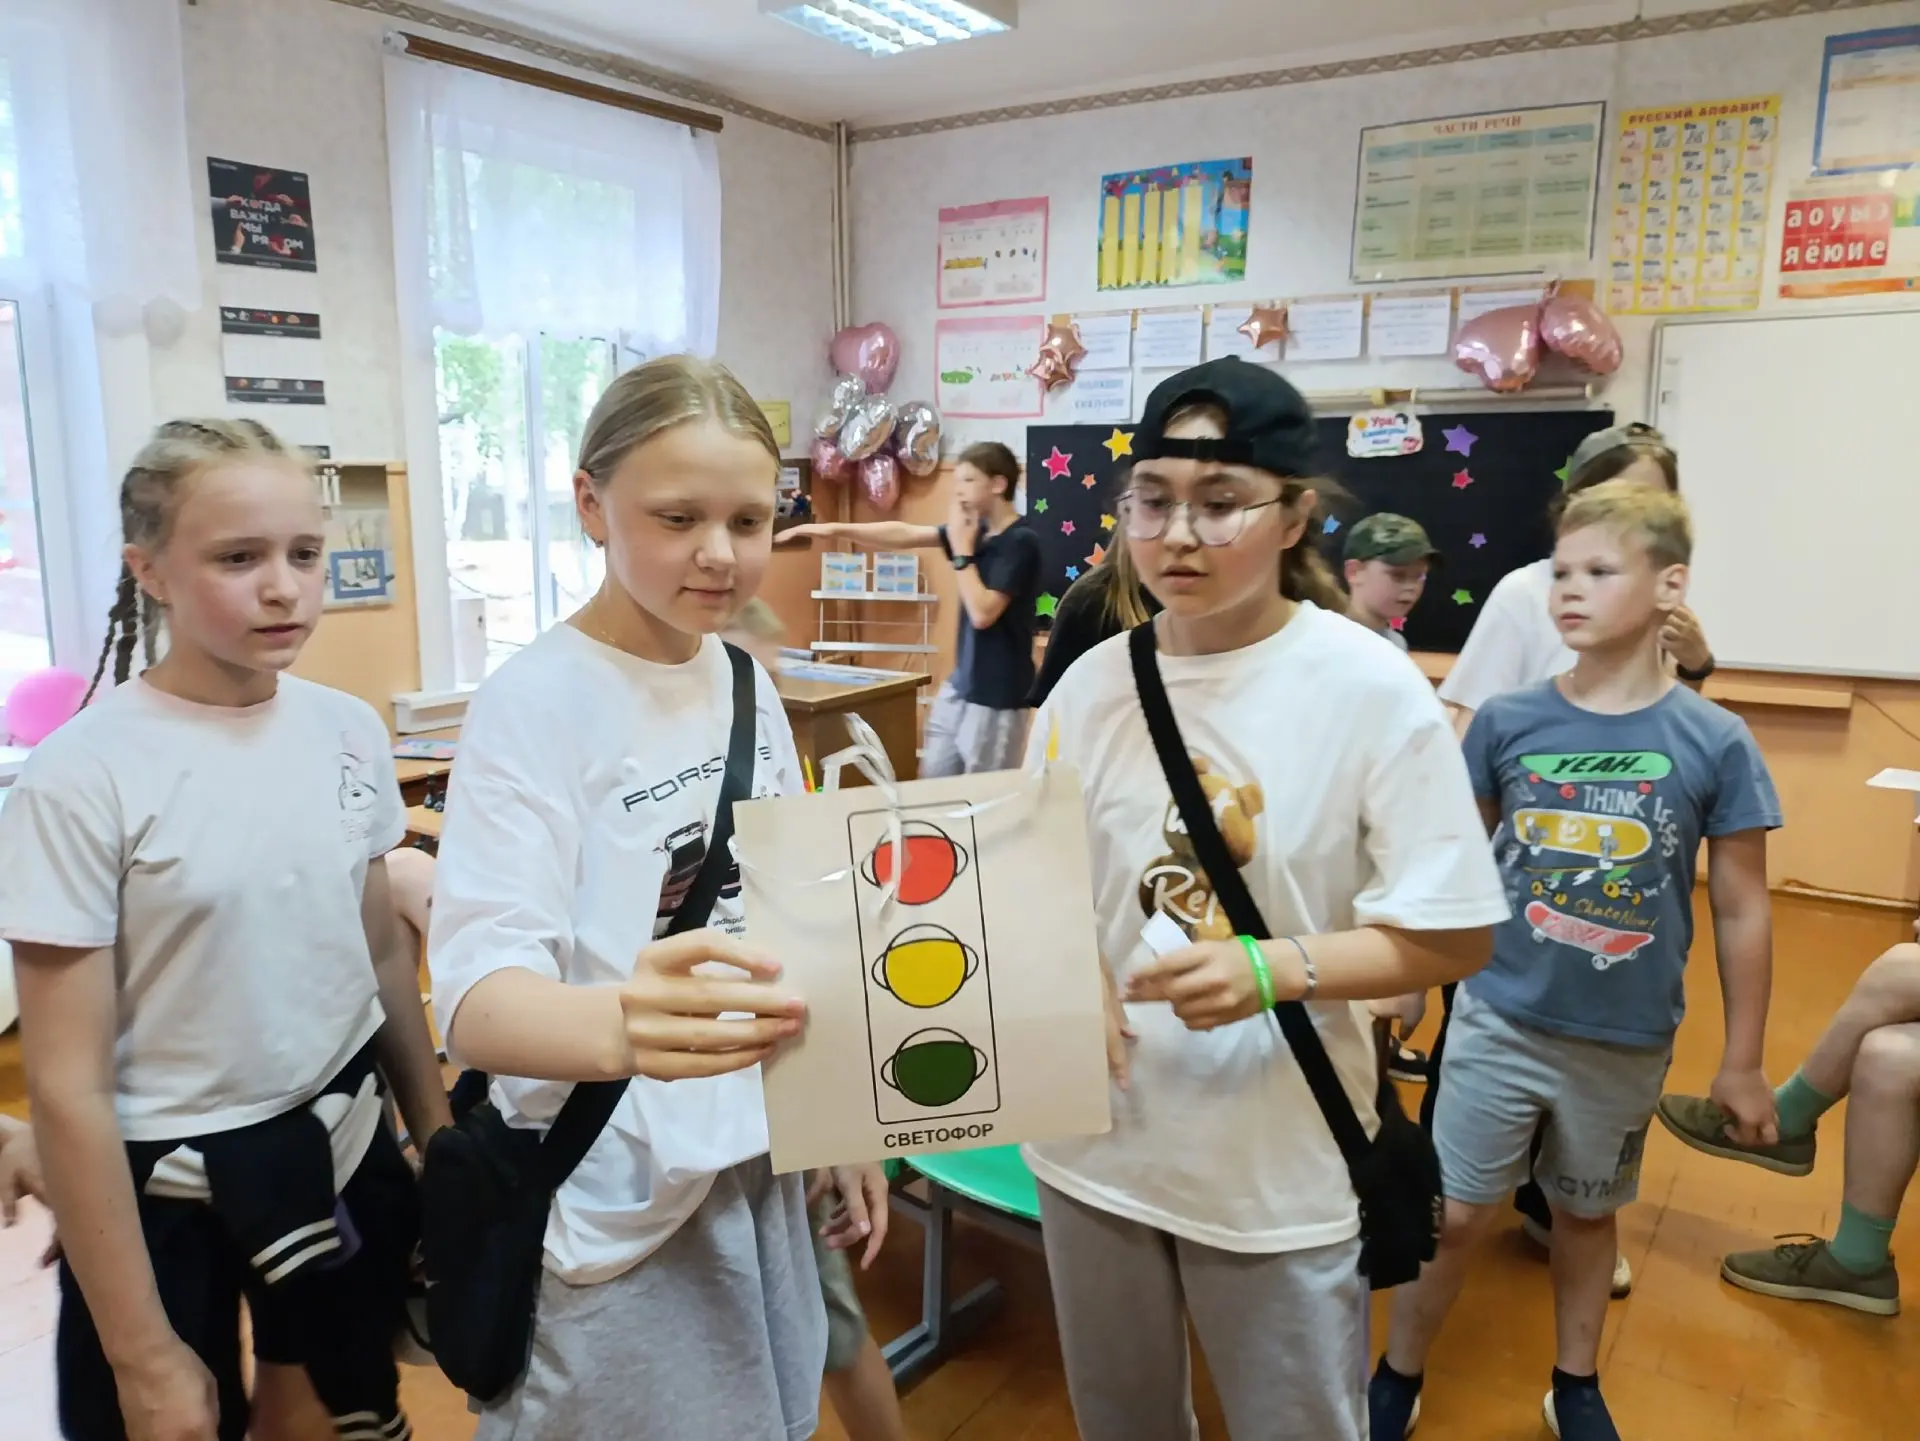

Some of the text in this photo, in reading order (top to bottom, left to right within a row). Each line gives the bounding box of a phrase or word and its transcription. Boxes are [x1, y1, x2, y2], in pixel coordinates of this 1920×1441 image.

[1629, 108, 1692, 124] РУССКИЙ
[622, 746, 771, 813] PORSCE
[1583, 785, 1647, 818] THINK
[884, 1123, 994, 1148] СВЕТОФОР
